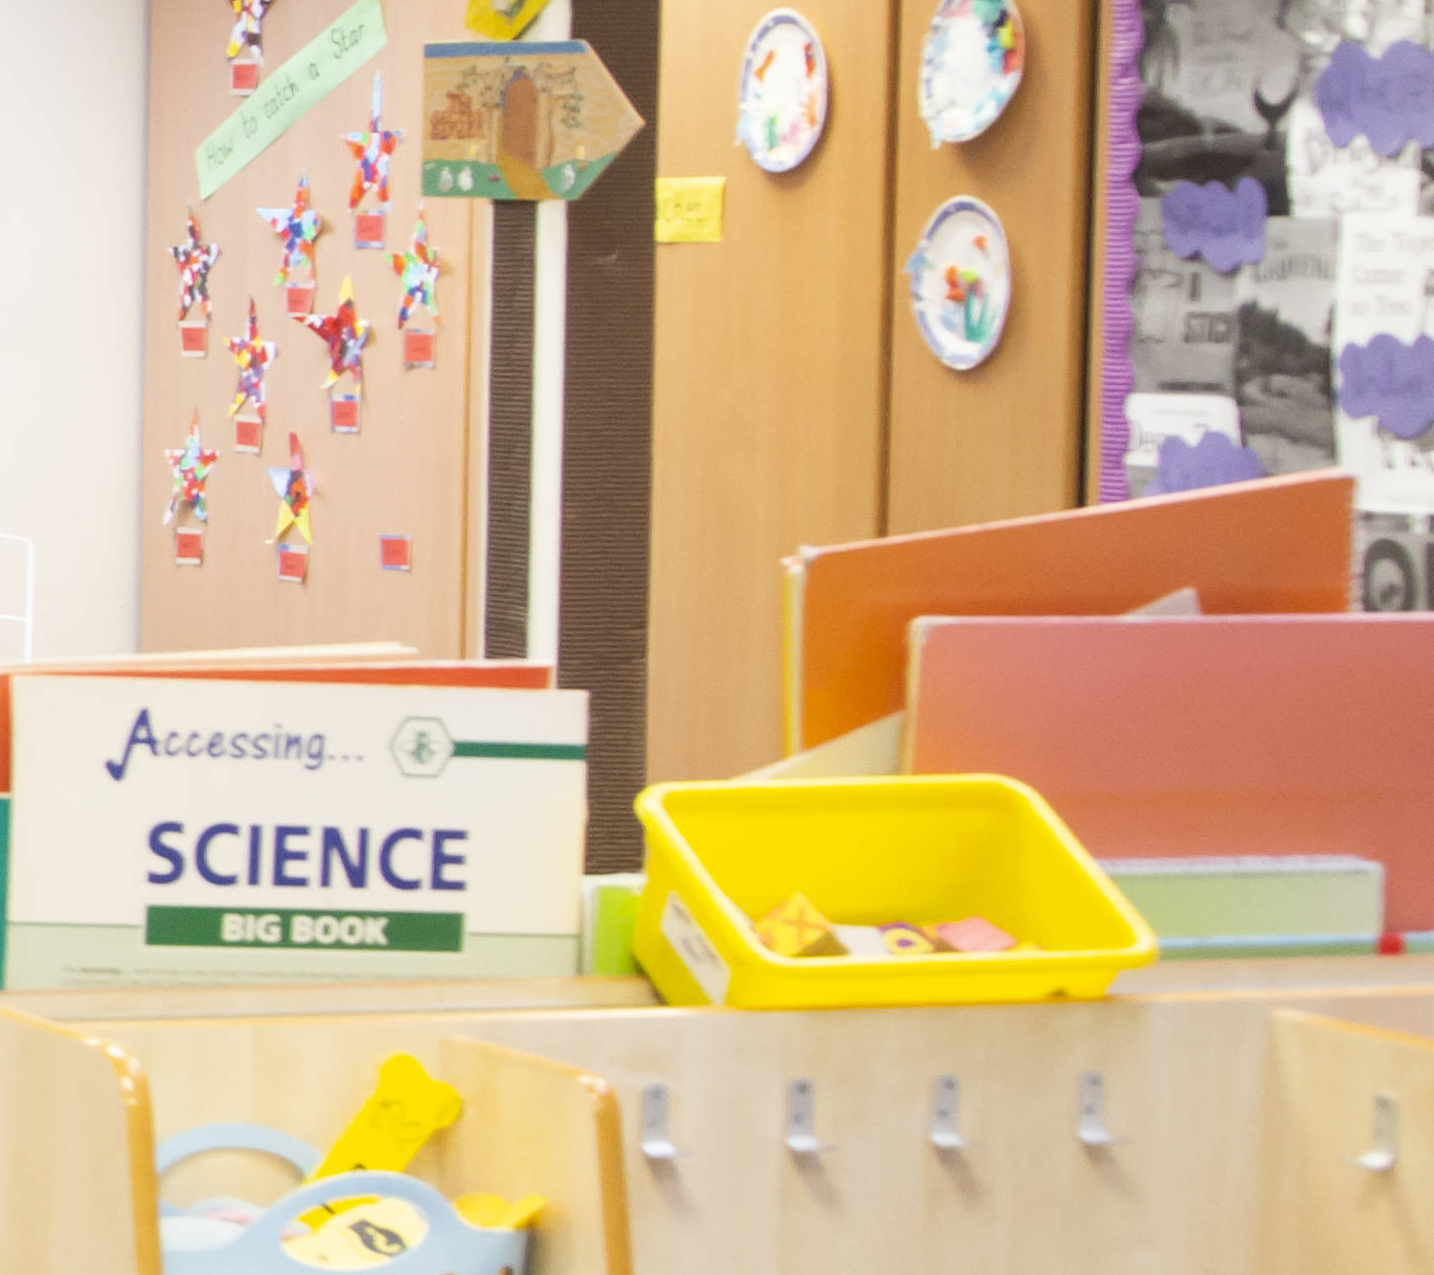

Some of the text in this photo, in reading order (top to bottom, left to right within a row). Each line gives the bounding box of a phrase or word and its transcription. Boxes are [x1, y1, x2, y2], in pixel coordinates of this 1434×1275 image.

[147, 821, 468, 890] SCIENCE
[221, 912, 388, 945] BIG BOOK
